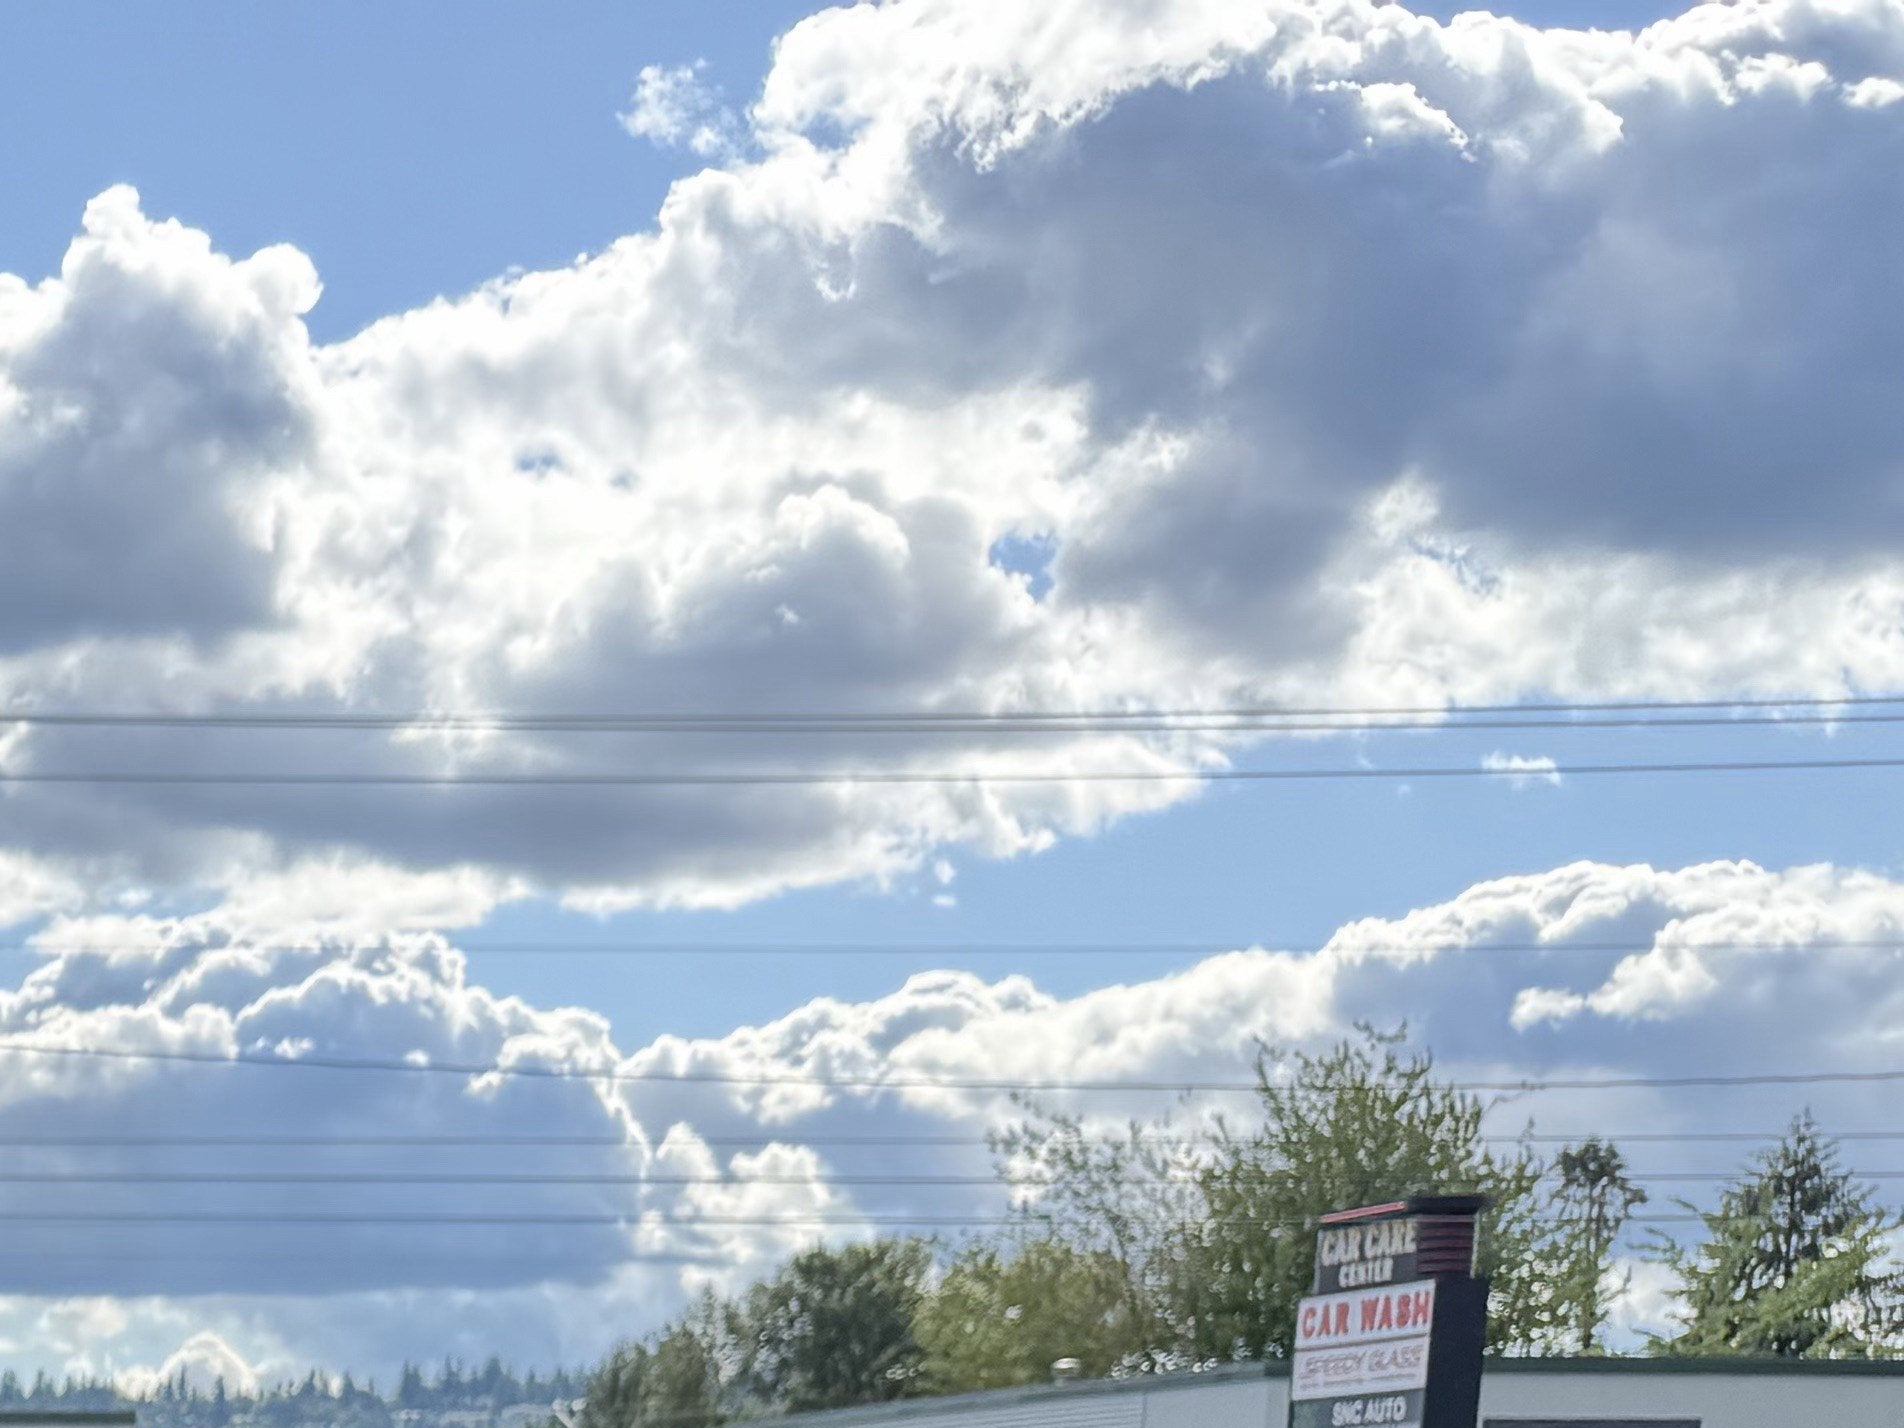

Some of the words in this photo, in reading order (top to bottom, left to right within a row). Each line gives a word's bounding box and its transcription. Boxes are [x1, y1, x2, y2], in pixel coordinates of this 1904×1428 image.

[1302, 1301, 1350, 1339] CAR
[1360, 1288, 1431, 1335] WASH
[1364, 1396, 1407, 1423] AUTO
